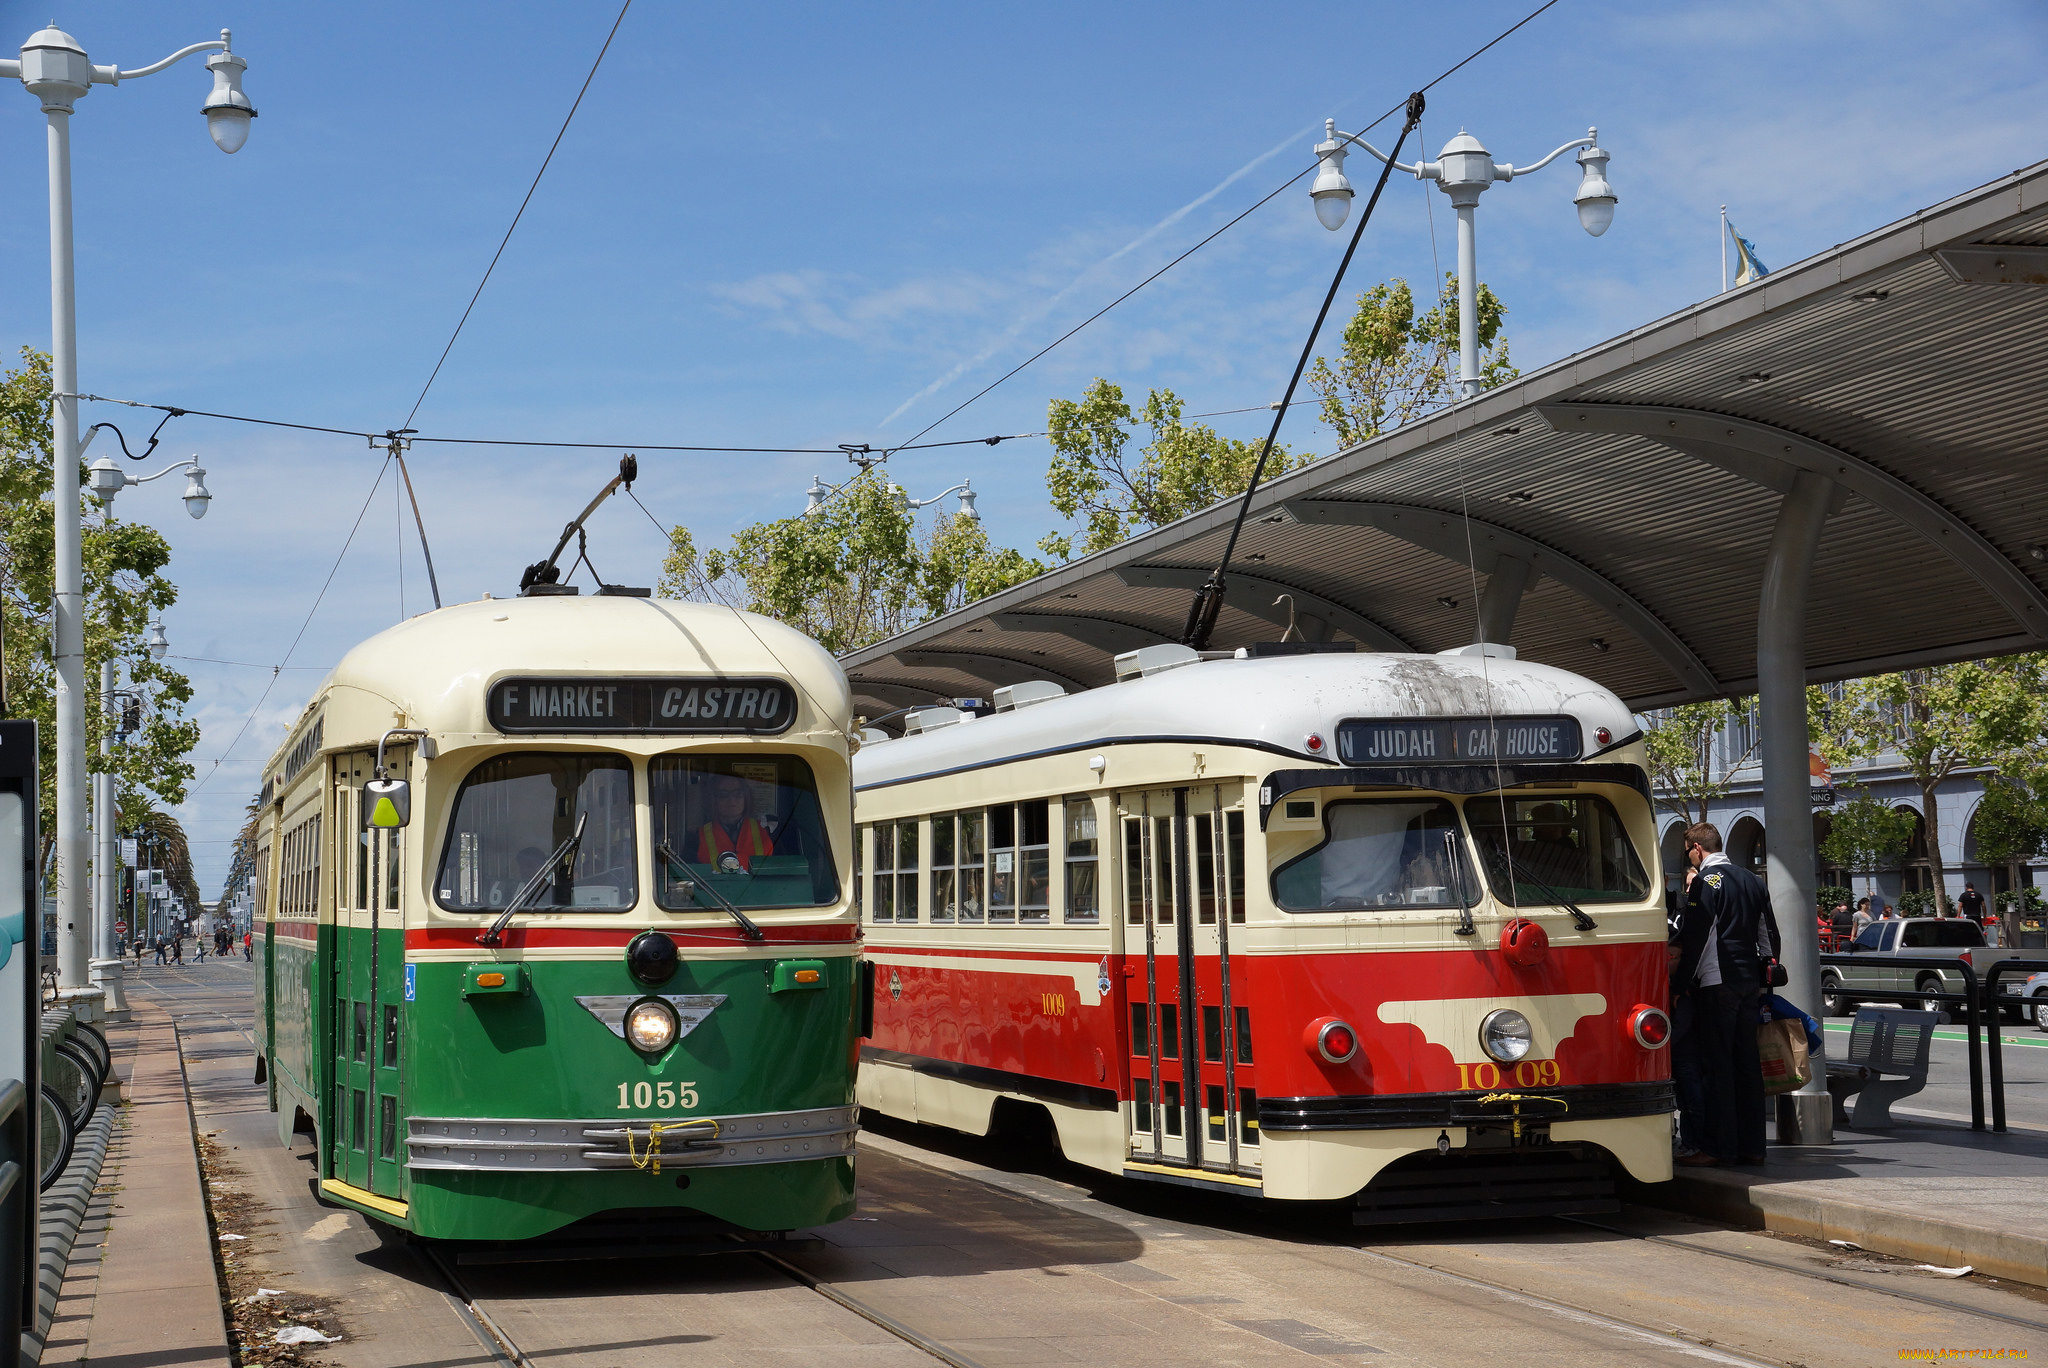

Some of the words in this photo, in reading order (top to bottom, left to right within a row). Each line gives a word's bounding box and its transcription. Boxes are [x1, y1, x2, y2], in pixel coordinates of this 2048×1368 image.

[503, 686, 518, 717] F
[529, 686, 617, 717] MARKET
[660, 687, 780, 719] CASTRO
[1340, 731, 1354, 758] N
[1368, 729, 1436, 757] JUDAH
[1467, 729, 1499, 756] CAR
[1506, 727, 1559, 755] HOUSE
[1811, 793, 1830, 802] NING
[490, 881, 502, 905] 6
[1042, 993, 1065, 1016] 1009
[617, 1081, 699, 1109] 1055
